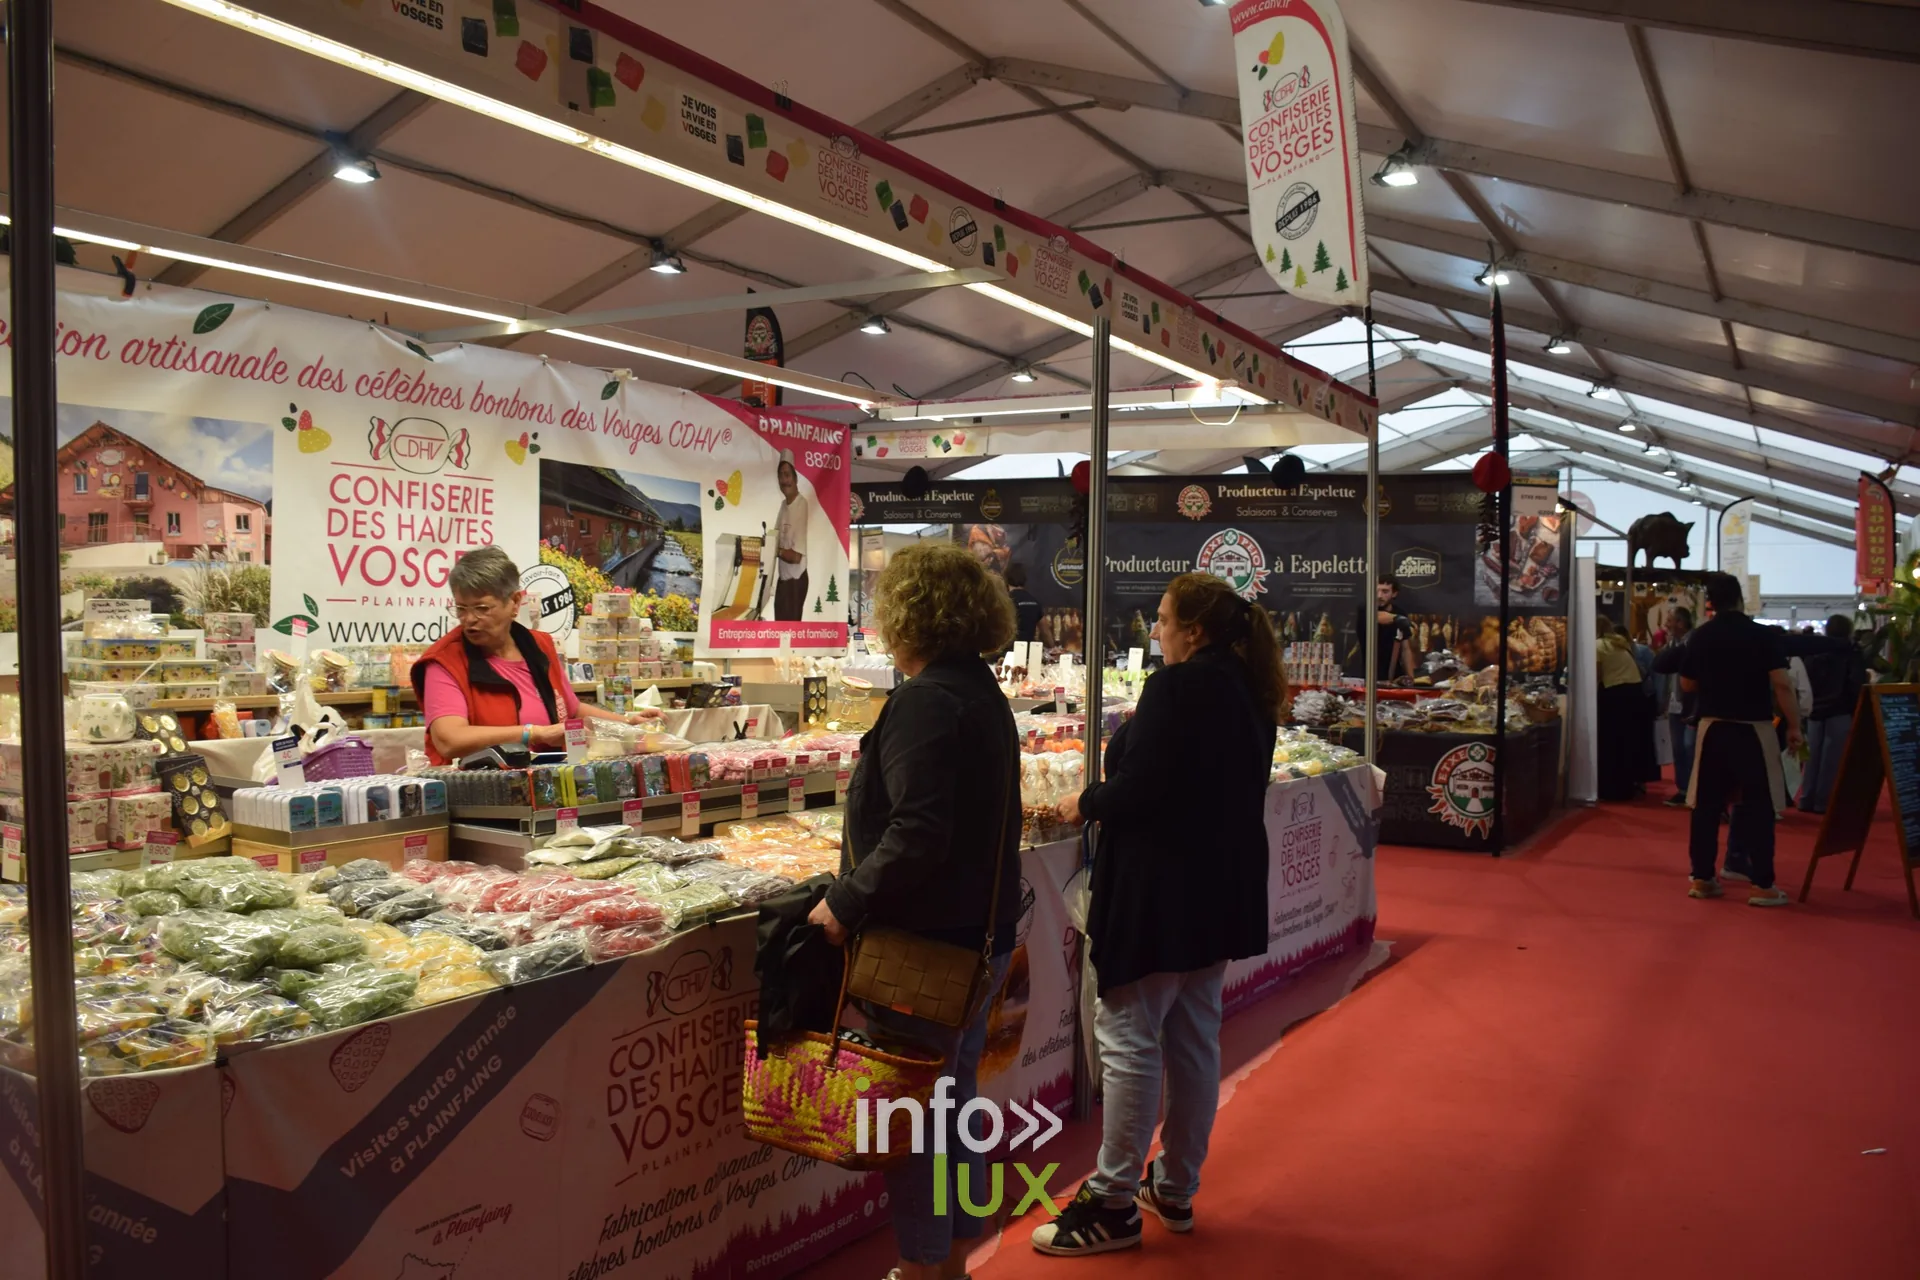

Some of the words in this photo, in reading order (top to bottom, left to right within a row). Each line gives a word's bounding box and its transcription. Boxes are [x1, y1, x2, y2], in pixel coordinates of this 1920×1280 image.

[392, 0, 444, 30] VOSGES
[681, 94, 694, 109] JE
[694, 100, 717, 119] VOIS
[692, 113, 705, 127] VIE
[1249, 85, 1330, 143] CONFISERIE
[682, 121, 717, 144] VOSGES
[1250, 136, 1274, 160] DES
[1279, 103, 1331, 144] HAUTES
[818, 150, 869, 182] CONFISERIE
[1251, 121, 1334, 180] VOSGES
[818, 163, 834, 180] DES
[837, 173, 868, 195] HAUTES
[820, 179, 868, 212] VOSGES
[1035, 269, 1069, 295] VOSGES
[120, 334, 289, 385] artisanale
[297, 355, 347, 393] des
[355, 367, 464, 410] célèbres
[470, 381, 556, 425] bonbons
[560, 401, 597, 431] des
[603, 407, 662, 455] Vosges
[759, 414, 768, 432] à
[769, 418, 844, 445] PLAINFAING
[394, 434, 444, 461] CDHV
[329, 473, 494, 515] CONFISERIE
[931, 491, 976, 505] Espelette
[1217, 485, 1287, 499] Producteur
[1298, 483, 1357, 501] Espelette
[327, 508, 386, 540] DES
[397, 513, 494, 546] HAUTES
[1236, 506, 1277, 518] Salaisons
[1281, 506, 1289, 517] &
[1291, 506, 1338, 518] Conserves
[327, 543, 468, 588] VOSG
[1273, 556, 1285, 574] à
[361, 596, 453, 608] PLAINFAIN
[553, 588, 574, 610] 1986
[718, 628, 756, 643] Entreprise
[797, 629, 806, 640] et
[807, 629, 839, 640] familiale
[1439, 750, 1466, 781] ETXE
[1282, 821, 1322, 848] CONFISERIE
[666, 966, 709, 1001] CDHV
[609, 998, 760, 1078] CONFISERIE
[1022, 1048, 1037, 1068] des
[1039, 1034, 1071, 1061] célèbres
[340, 1116, 410, 1179] Visites
[408, 1067, 457, 1119] toute
[456, 1005, 517, 1071] l'année
[606, 1069, 661, 1117] DES
[670, 1038, 745, 1093] HAUTE
[390, 1156, 406, 1174] à
[404, 1053, 503, 1160] PLAINFAING
[610, 1072, 740, 1164] VOSGE
[445, 1204, 512, 1240] Plainfaing
[599, 1182, 699, 1245] Fabrication
[632, 1210, 704, 1260] bonbons
[727, 1170, 778, 1208] Vosges
[746, 1223, 836, 1274] Retrouvez-nous
